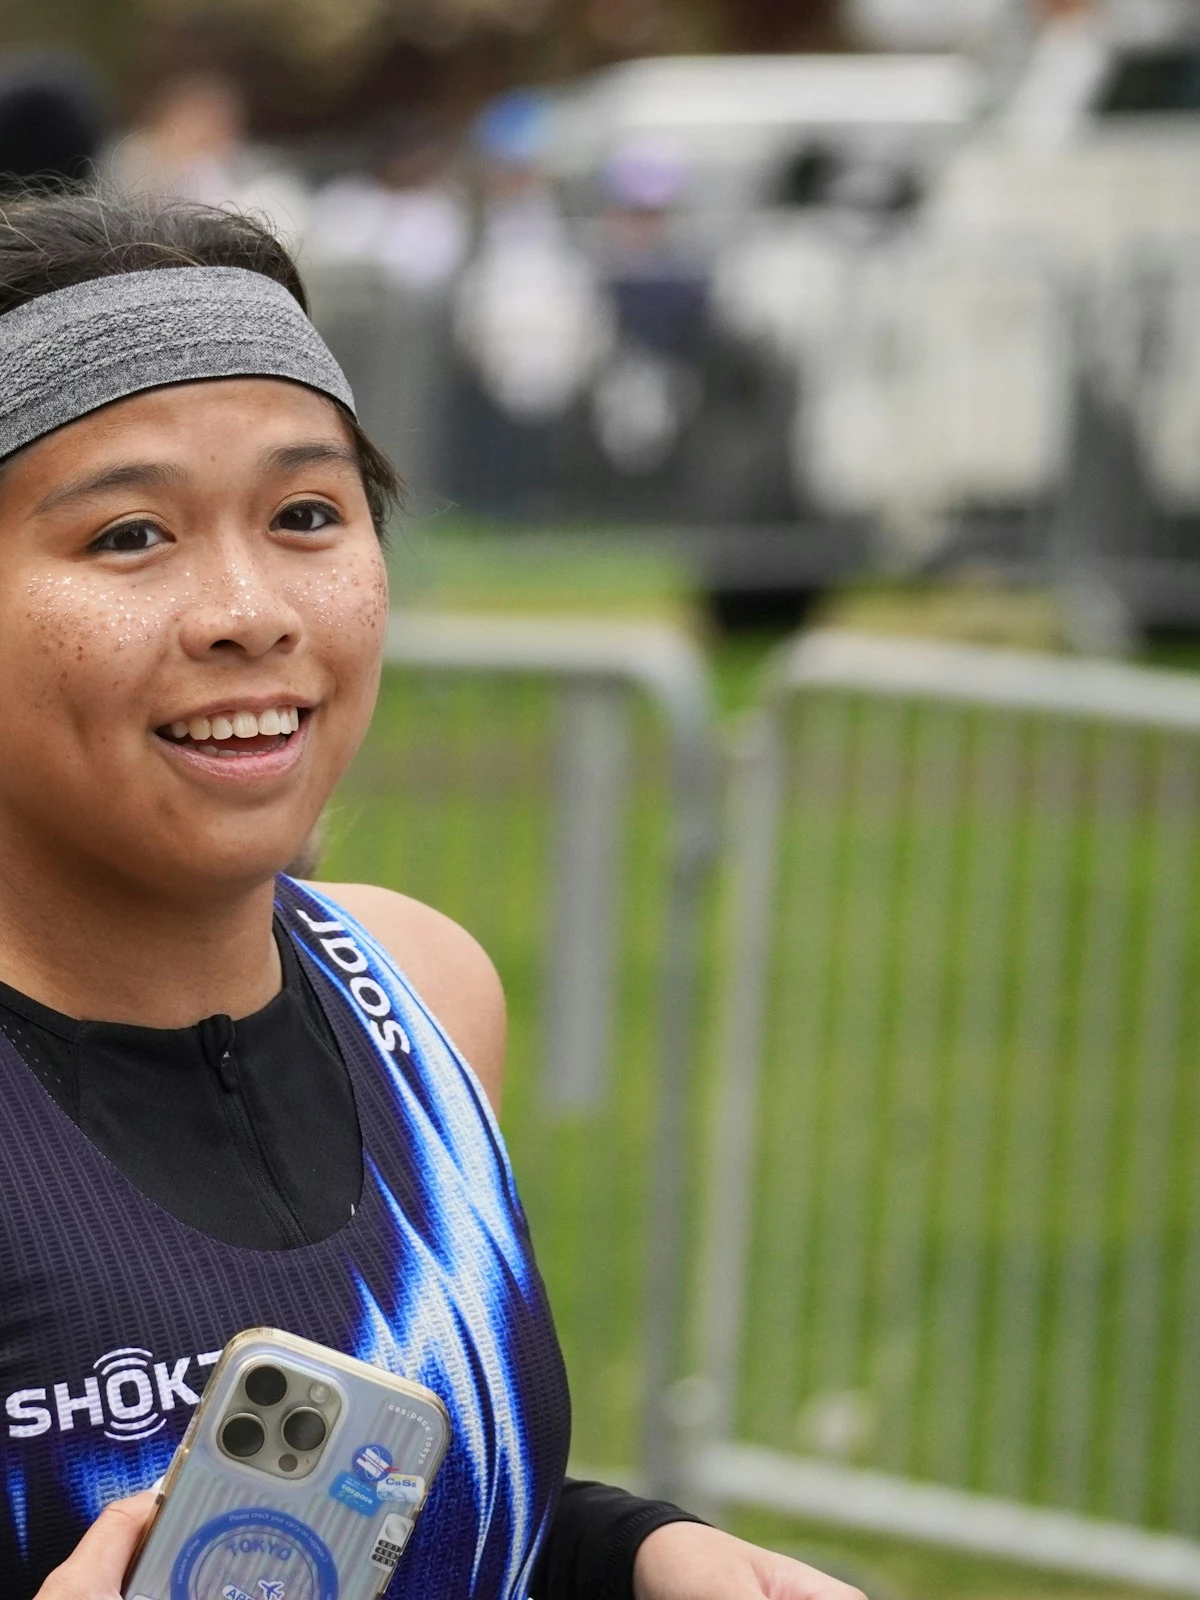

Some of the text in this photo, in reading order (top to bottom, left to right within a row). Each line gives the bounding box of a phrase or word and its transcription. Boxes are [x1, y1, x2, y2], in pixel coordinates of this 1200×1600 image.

[296, 909, 410, 1054] soar
[418, 1436, 434, 1464] tokyo
[226, 1537, 292, 1561] TOKYO
